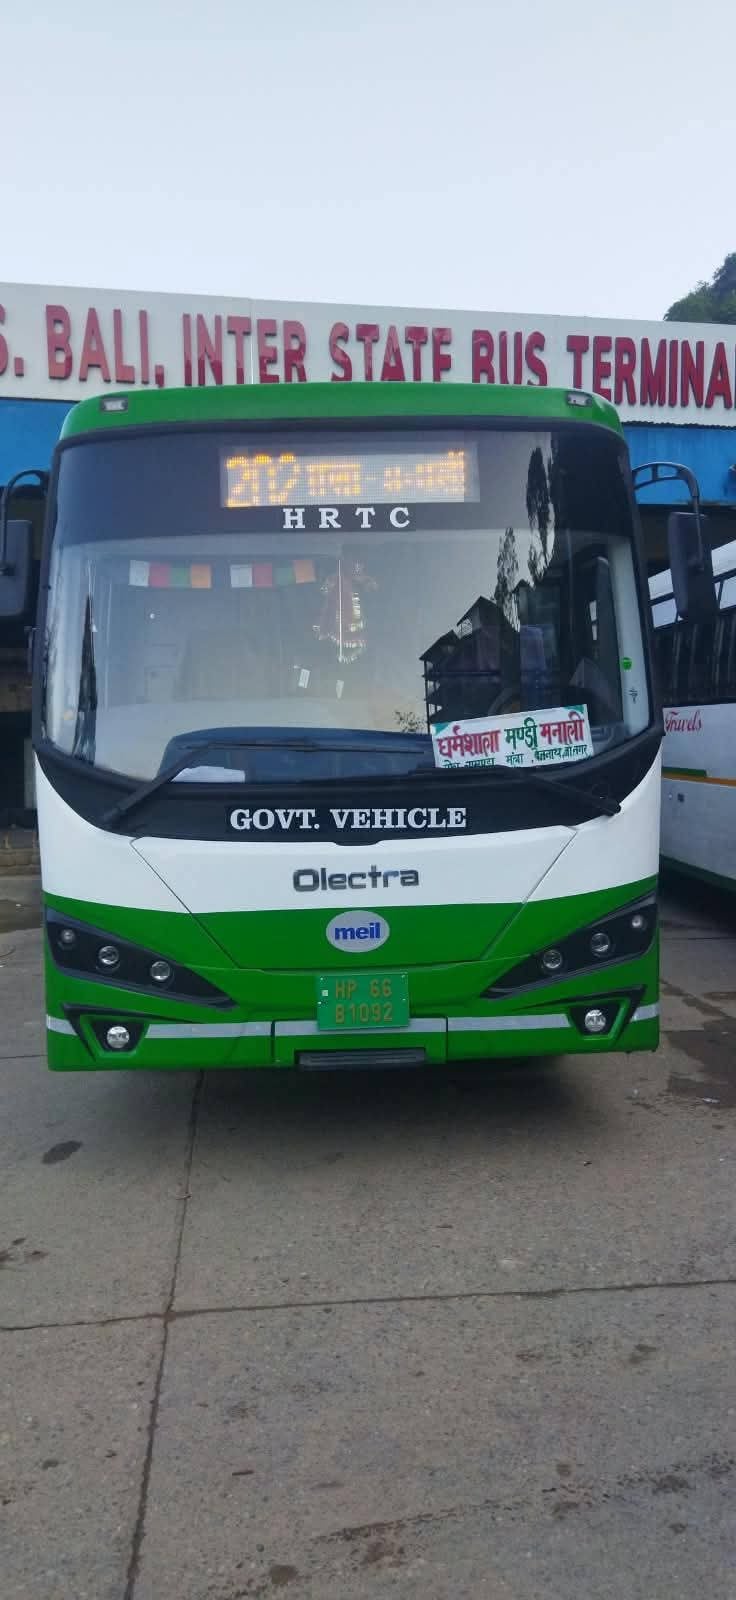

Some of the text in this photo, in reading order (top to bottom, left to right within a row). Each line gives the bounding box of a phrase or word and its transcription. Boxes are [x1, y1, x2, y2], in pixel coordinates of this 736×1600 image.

[45, 305, 164, 388] BALI,
[182, 313, 307, 386] INTER
[329, 322, 452, 383] STATE
[472, 329, 548, 386] BUS
[566, 335, 736, 409] TERMINA
[539, 710, 585, 746] मनाली
[230, 807, 467, 831] GOVT. VEHICLE
[293, 865, 420, 893] Olectra
[334, 921, 381, 941] meil
[335, 977, 393, 1000] HP 66
